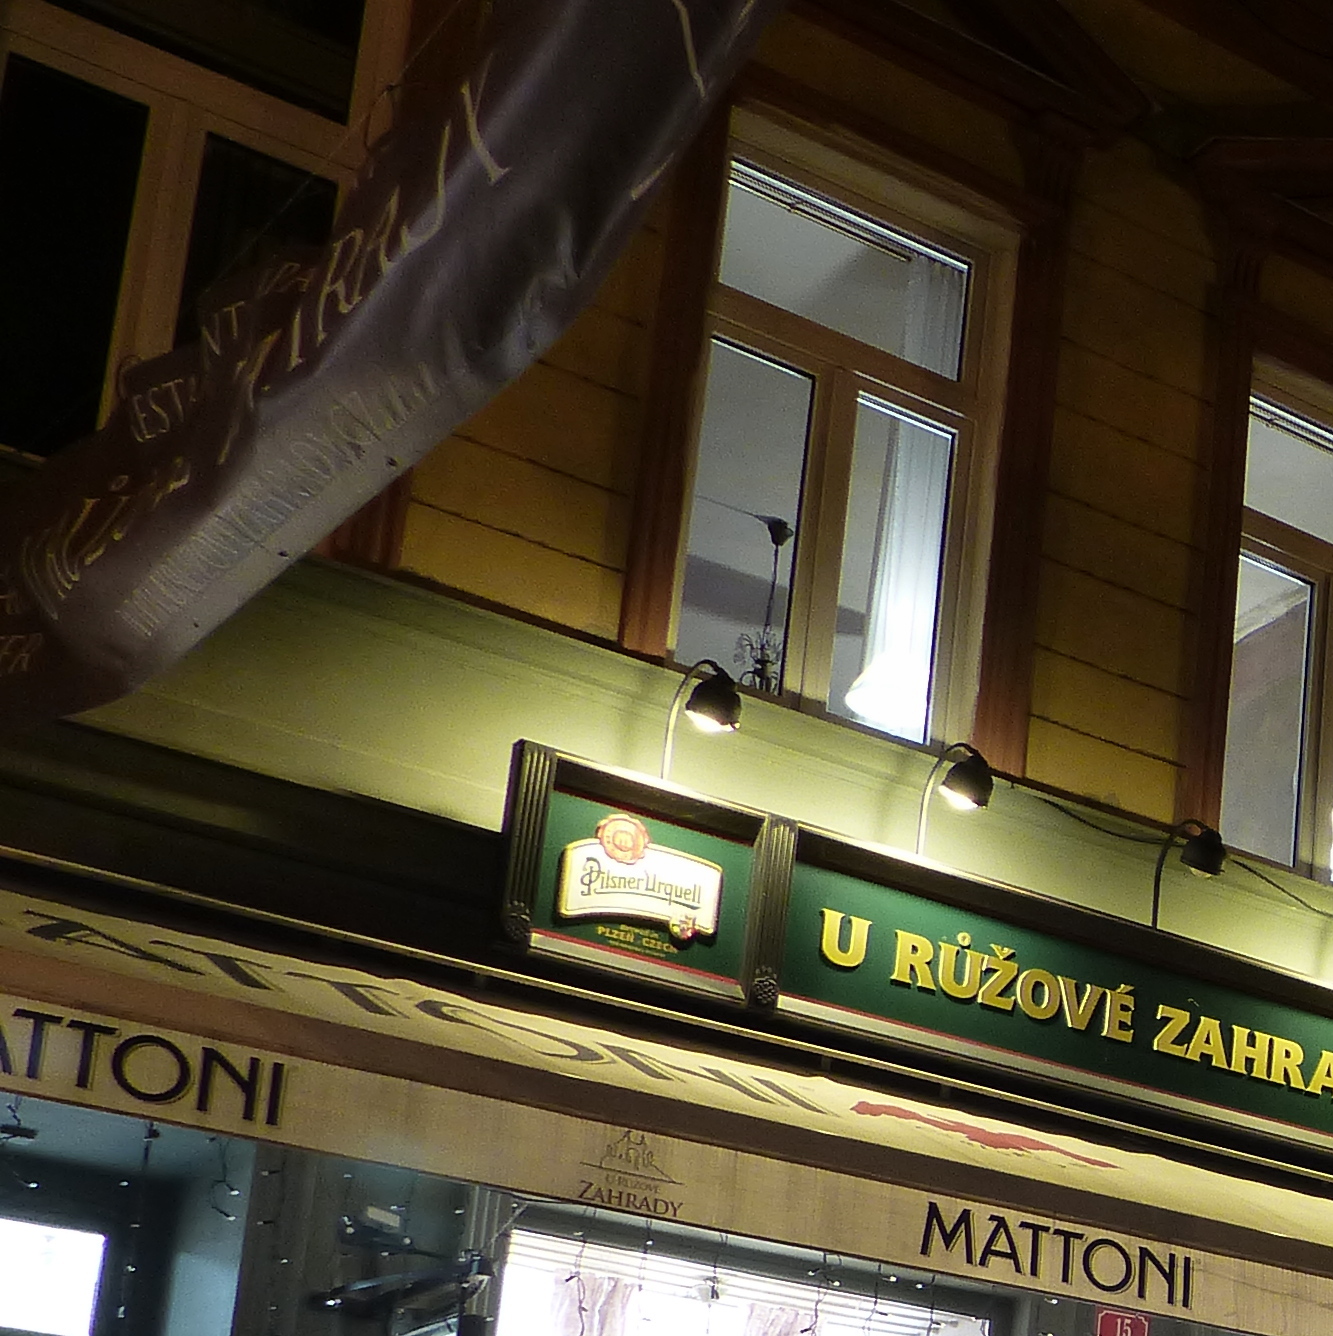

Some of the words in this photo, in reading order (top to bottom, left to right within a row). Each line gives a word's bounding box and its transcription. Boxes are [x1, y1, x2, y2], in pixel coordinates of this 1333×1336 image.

[580, 856, 644, 896] Pilsner
[645, 870, 702, 905] Urquell
[0, 908, 828, 1115] ATTONI
[820, 907, 873, 969] U
[890, 929, 1137, 1044] RŮŽOVÉ
[578, 1179, 684, 1218] ZAHRADY
[919, 1200, 1194, 1309] MATTONI
